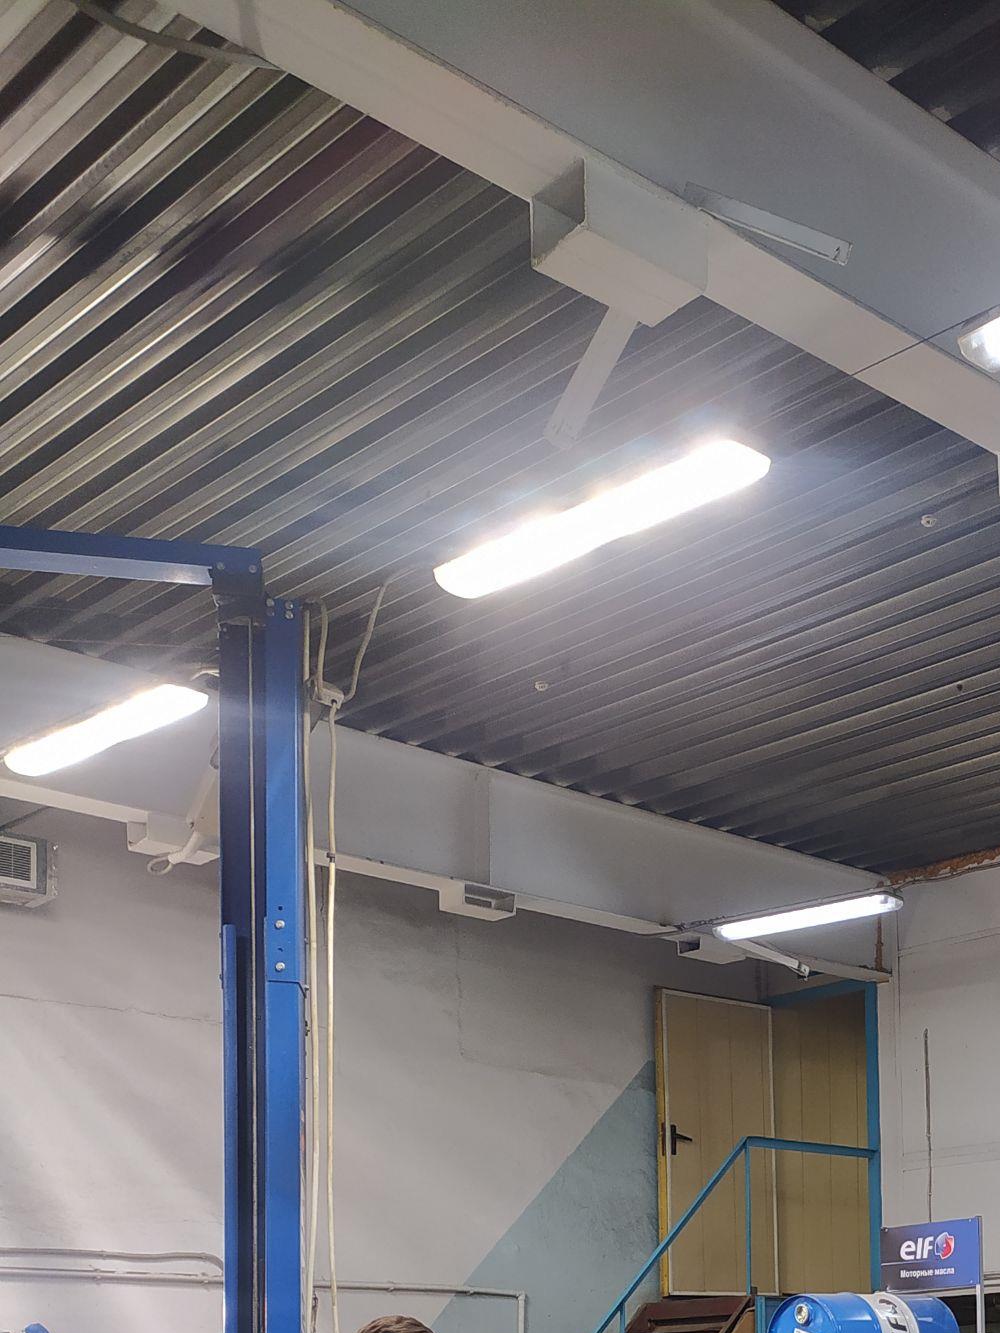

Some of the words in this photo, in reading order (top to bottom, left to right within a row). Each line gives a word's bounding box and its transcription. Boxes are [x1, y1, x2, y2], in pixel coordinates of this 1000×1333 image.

[900, 1236, 934, 1260] elf
[900, 1269, 933, 1278] Моторные
[934, 1267, 955, 1275] масла
